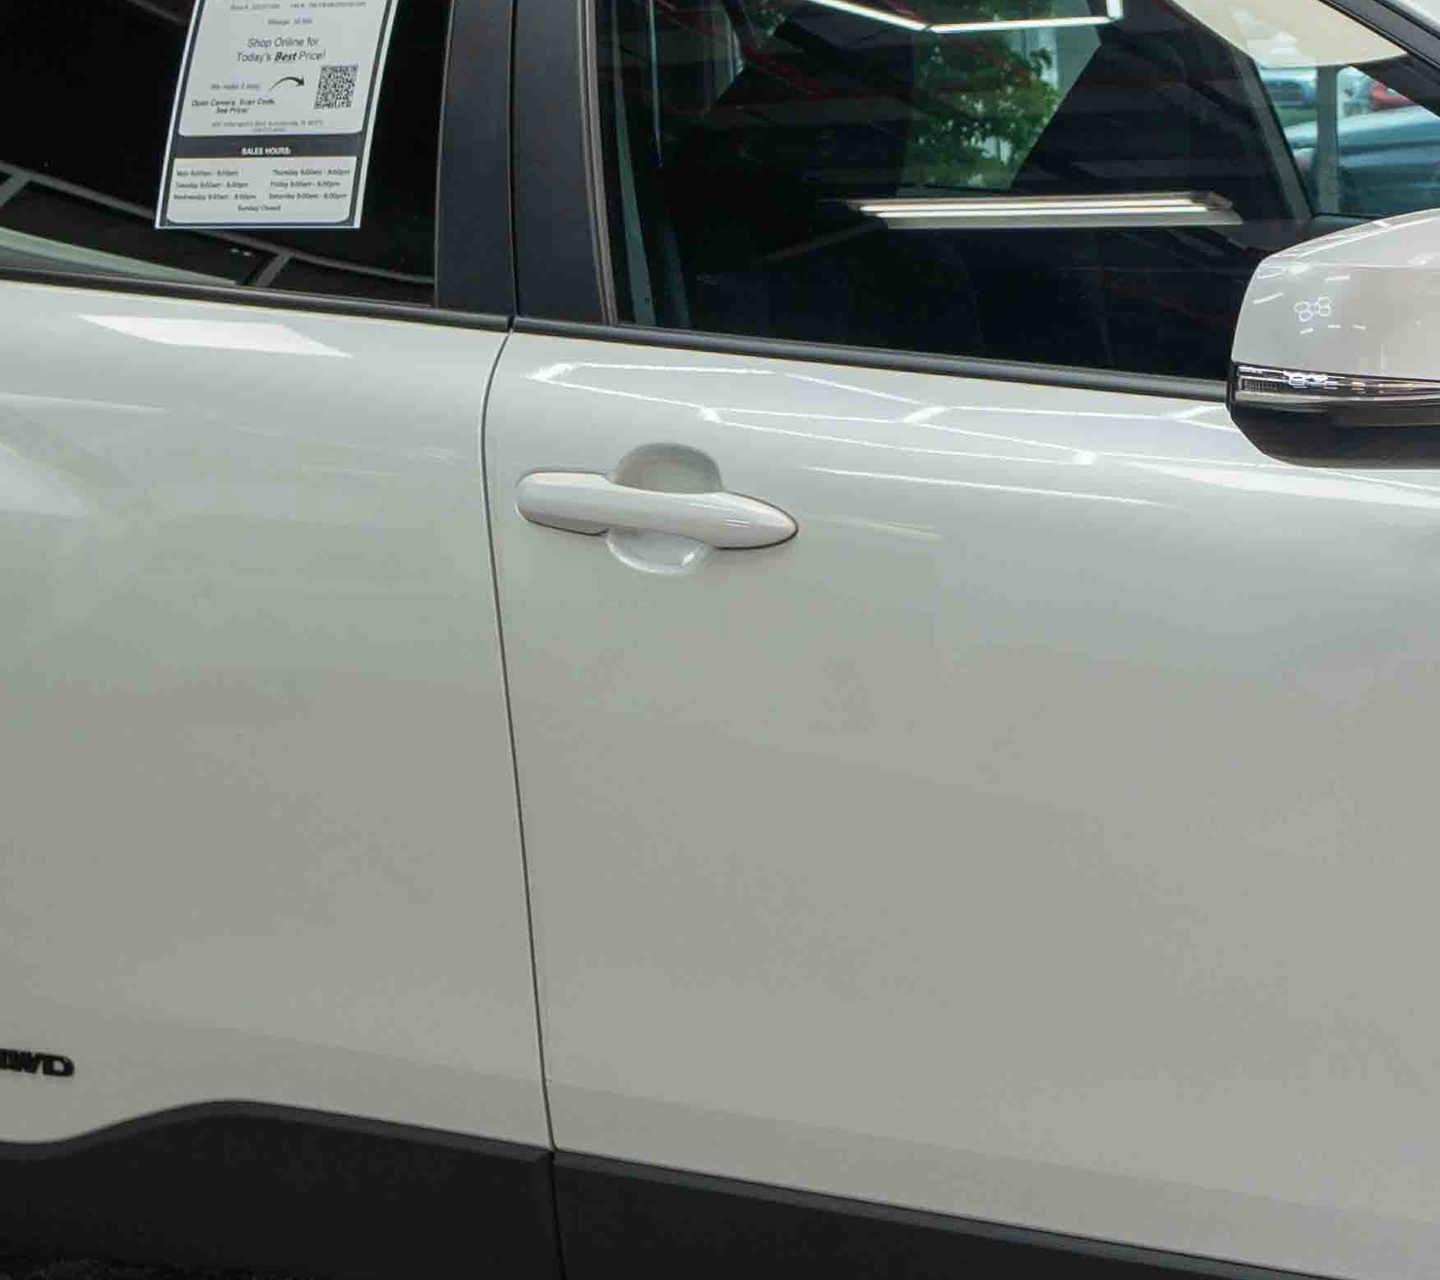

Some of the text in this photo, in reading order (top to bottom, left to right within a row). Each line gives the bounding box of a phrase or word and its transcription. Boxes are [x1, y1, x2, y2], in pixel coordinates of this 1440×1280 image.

[247, 37, 319, 49] Shop Online for
[236, 51, 272, 63] Today's
[274, 51, 298, 62] Best
